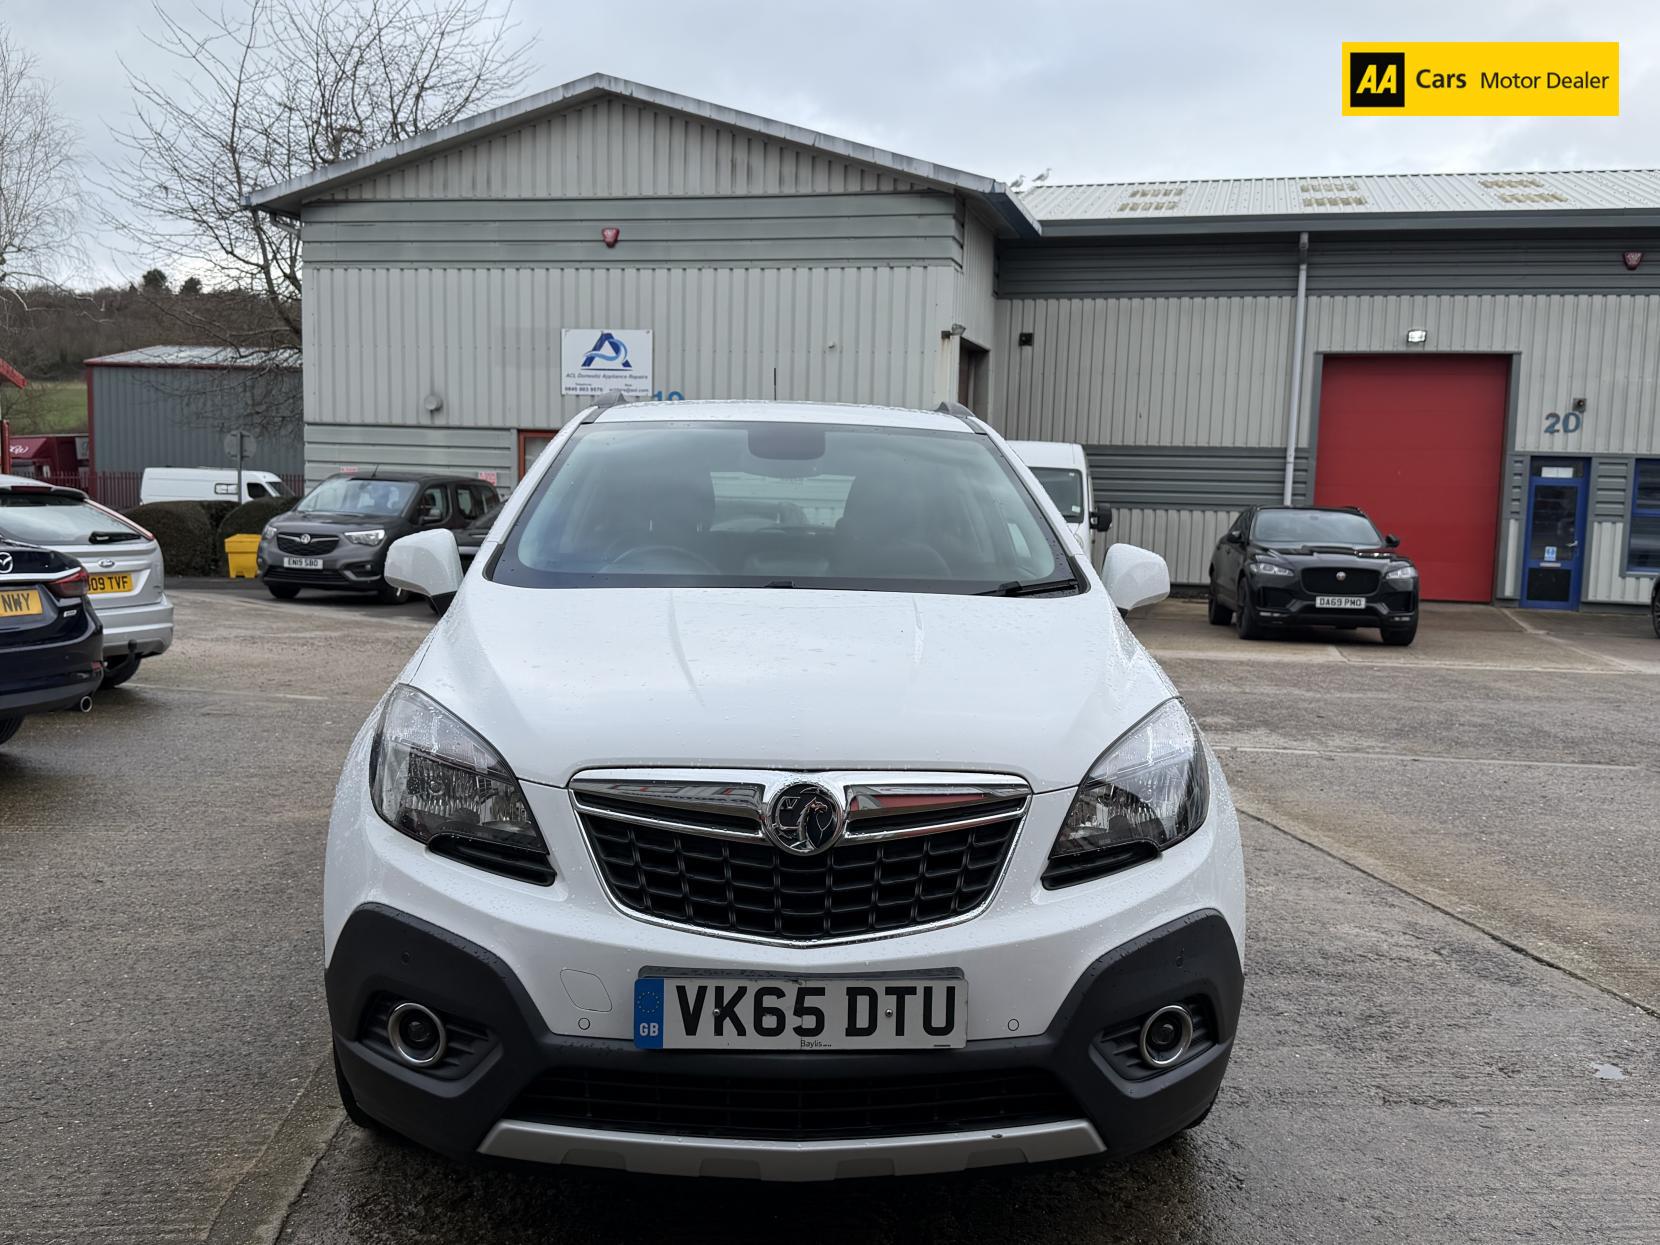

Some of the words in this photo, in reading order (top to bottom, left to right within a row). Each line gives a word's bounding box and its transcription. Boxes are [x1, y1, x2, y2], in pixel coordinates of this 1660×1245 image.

[1544, 412, 1581, 433] 20
[88, 577, 106, 591] 09
[107, 575, 128, 591] TVF
[1, 593, 30, 612] NWY
[1319, 597, 1343, 606] DA69
[676, 985, 826, 1037] VK65
[845, 985, 956, 1037] DTU
[639, 1023, 659, 1037] GB
